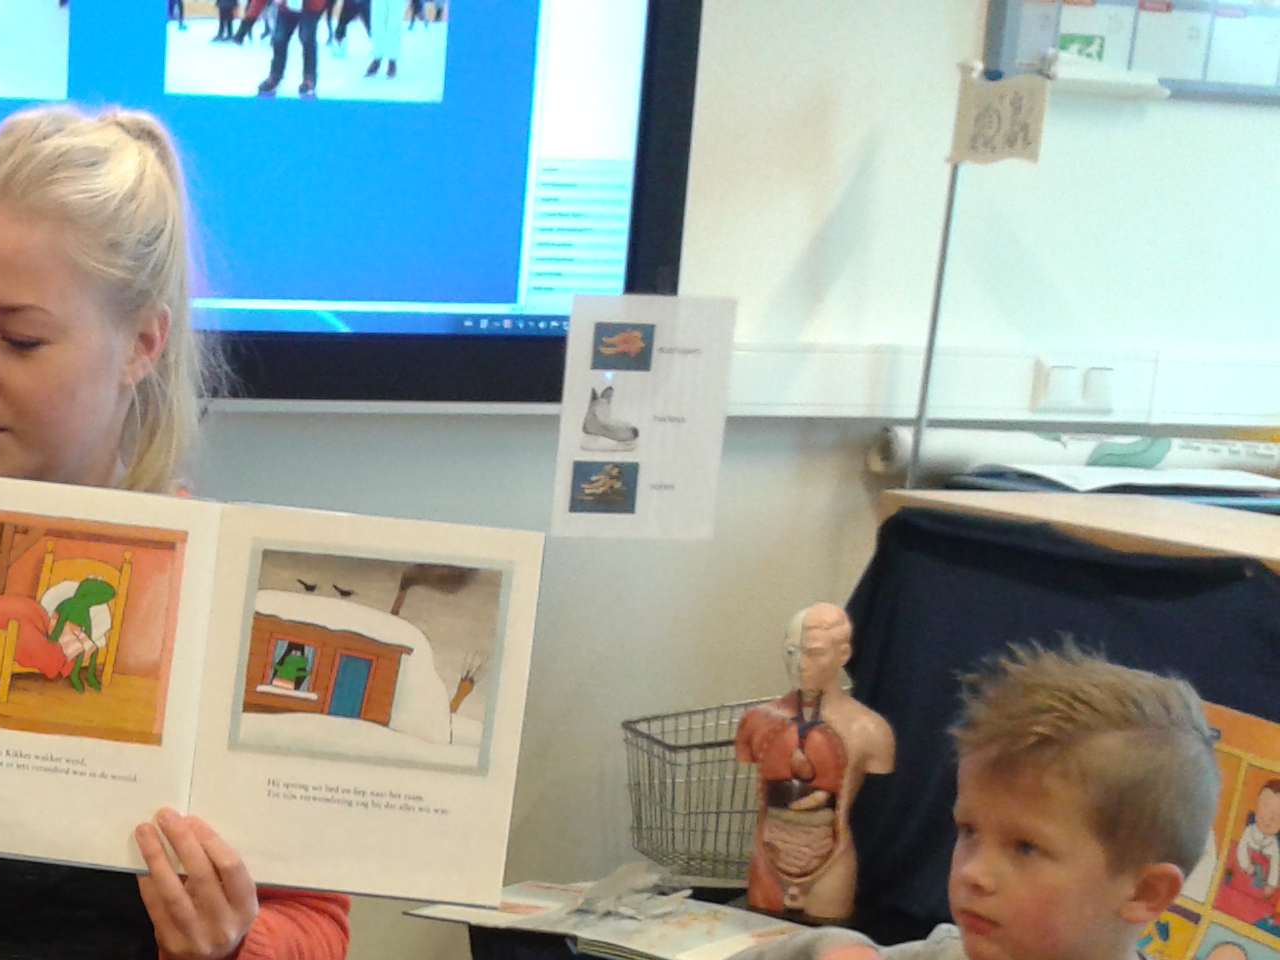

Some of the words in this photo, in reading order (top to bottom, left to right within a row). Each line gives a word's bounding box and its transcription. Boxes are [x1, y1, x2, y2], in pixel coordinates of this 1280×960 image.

[5, 748, 32, 760] Kikker
[34, 753, 63, 763] wakker
[31, 764, 70, 776] veranderd
[72, 769, 87, 777] was
[89, 771, 98, 779] in
[98, 771, 109, 780] de
[282, 783, 310, 793] sprong
[325, 784, 339, 794] bed
[389, 790, 402, 799] het
[299, 794, 353, 807] verwondering
[384, 801, 397, 810] dat
[399, 803, 416, 812] alles
